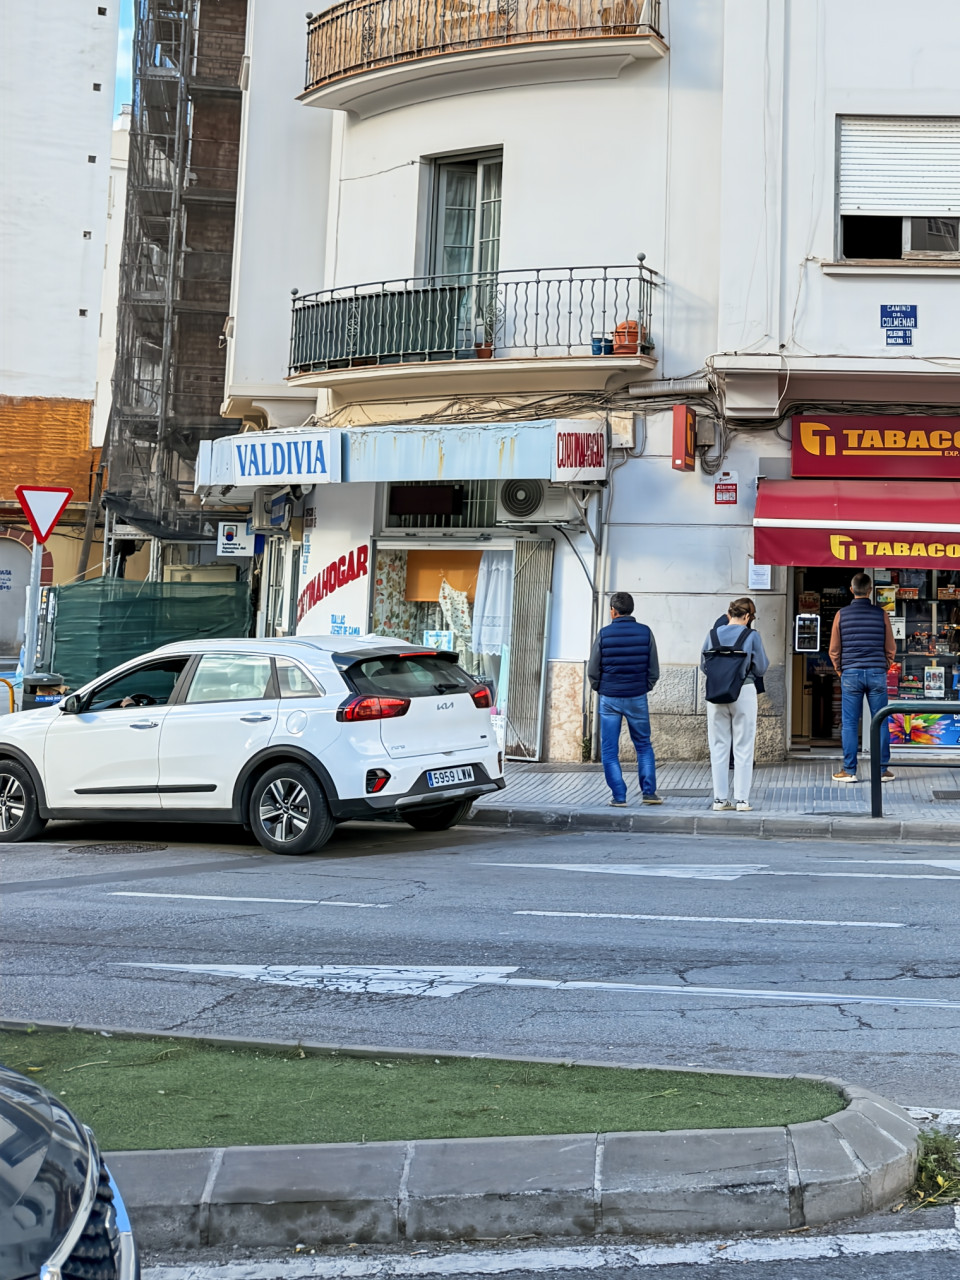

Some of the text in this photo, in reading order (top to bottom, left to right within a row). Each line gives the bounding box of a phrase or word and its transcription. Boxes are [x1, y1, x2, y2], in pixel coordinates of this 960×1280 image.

[882, 317, 915, 327] COLMENAR
[236, 439, 328, 477] VALDIVIA
[433, 770, 455, 784] 5959
